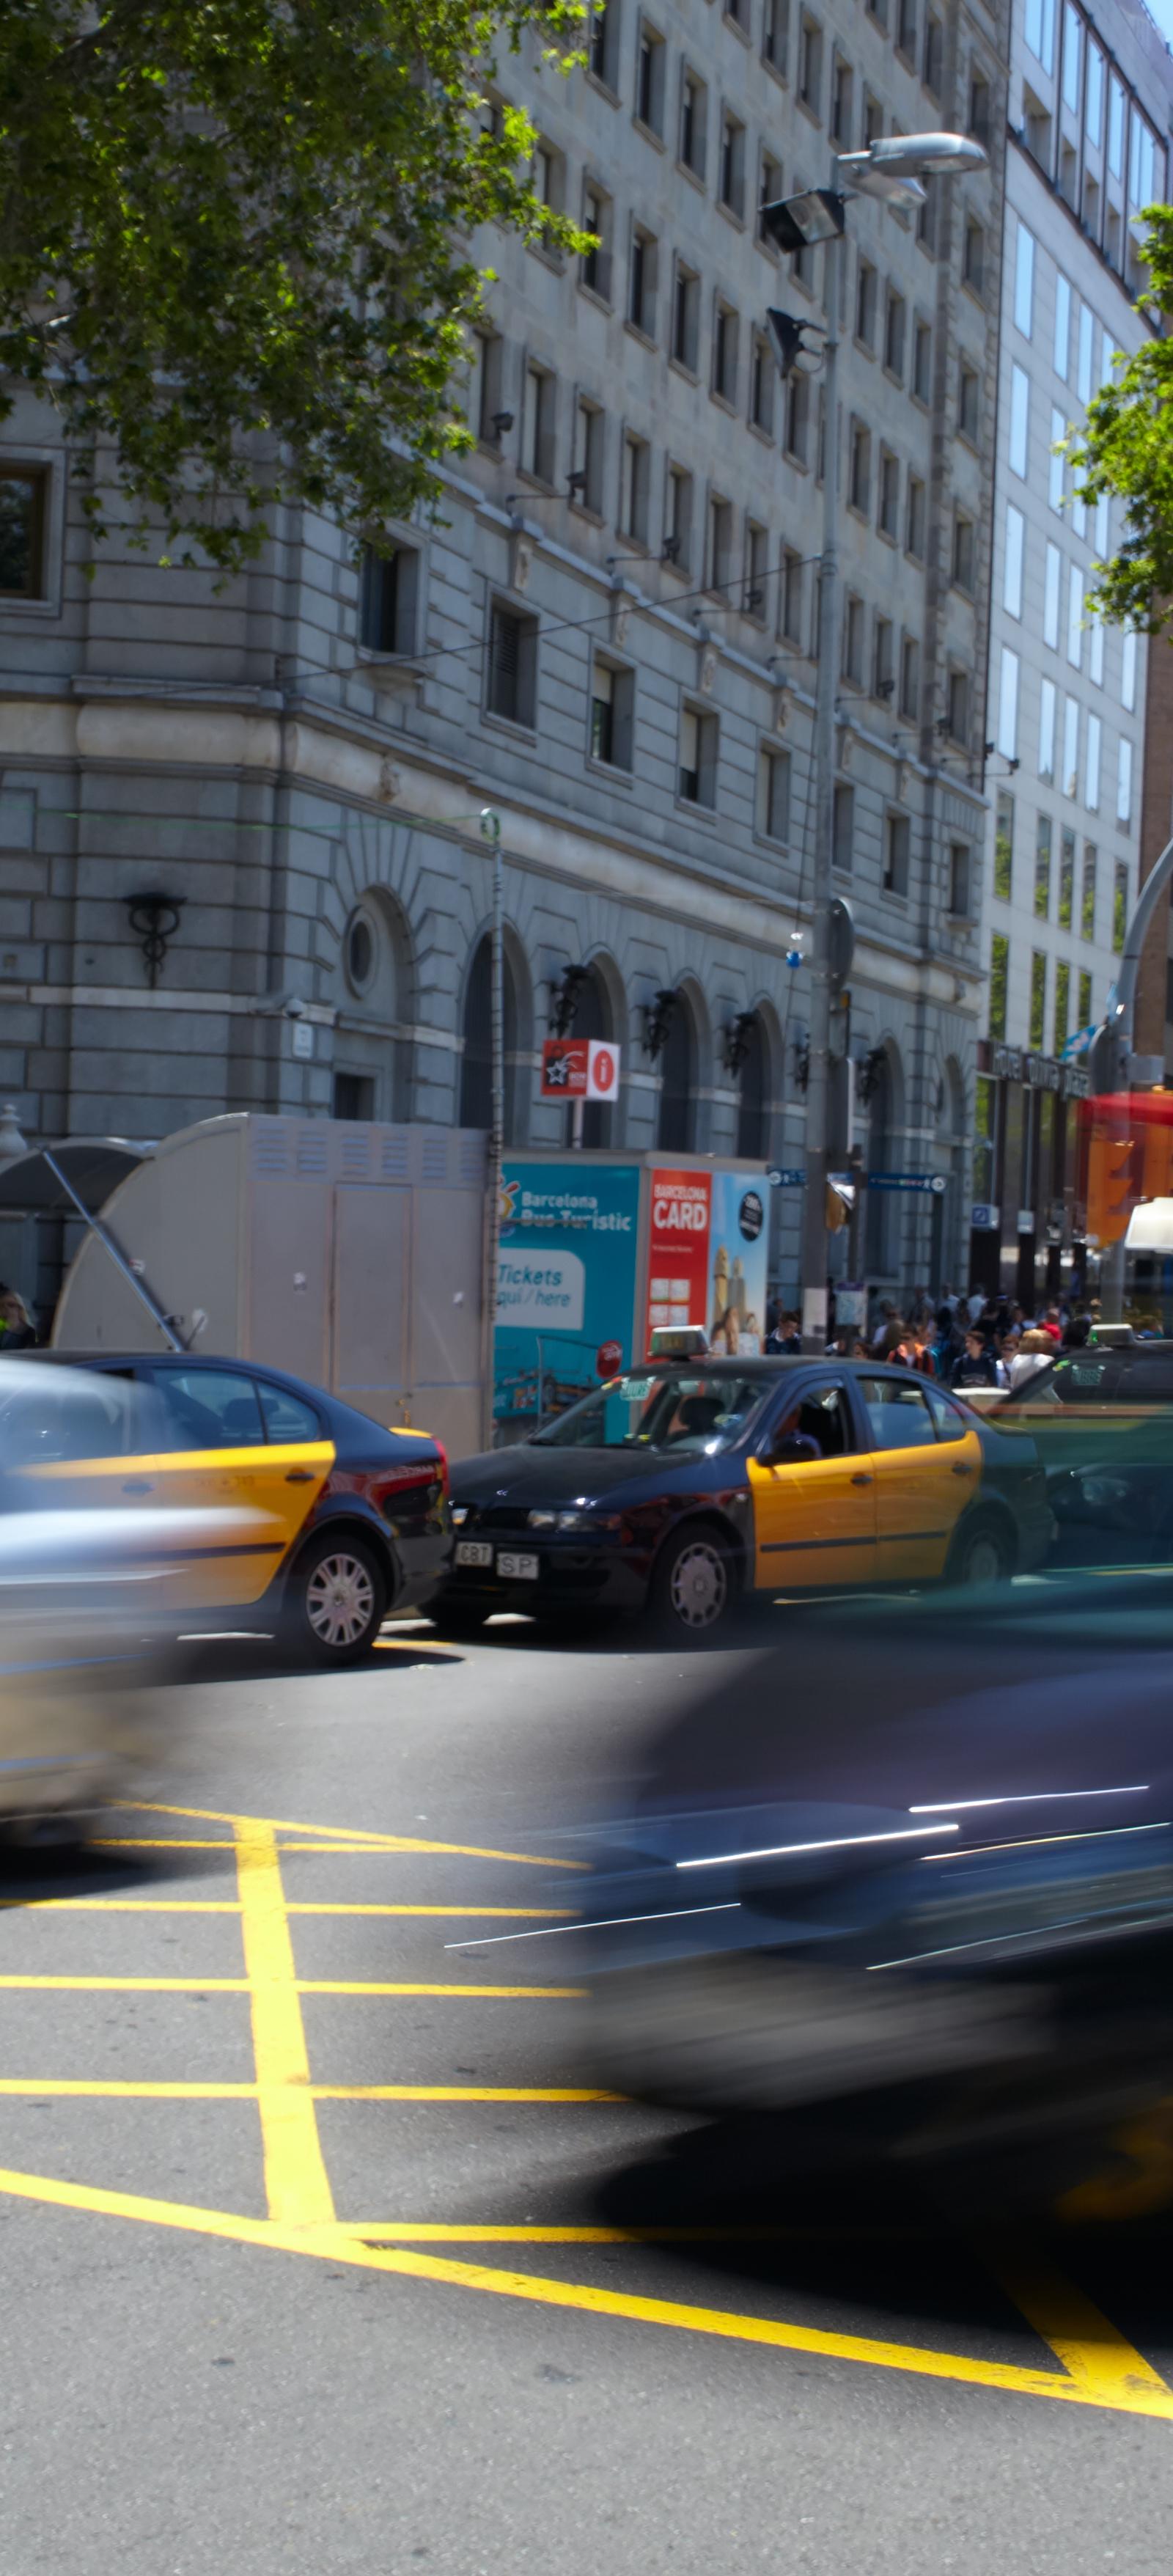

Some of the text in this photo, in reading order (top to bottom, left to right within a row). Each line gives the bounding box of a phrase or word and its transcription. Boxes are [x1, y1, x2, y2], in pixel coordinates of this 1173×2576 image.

[522, 1192, 598, 1208] Barcelona
[653, 1184, 707, 1201] BARCELONA
[653, 1200, 707, 1231] CARD
[499, 1264, 563, 1287] Tickets
[534, 1291, 571, 1307] here
[461, 1545, 488, 1563] CBT
